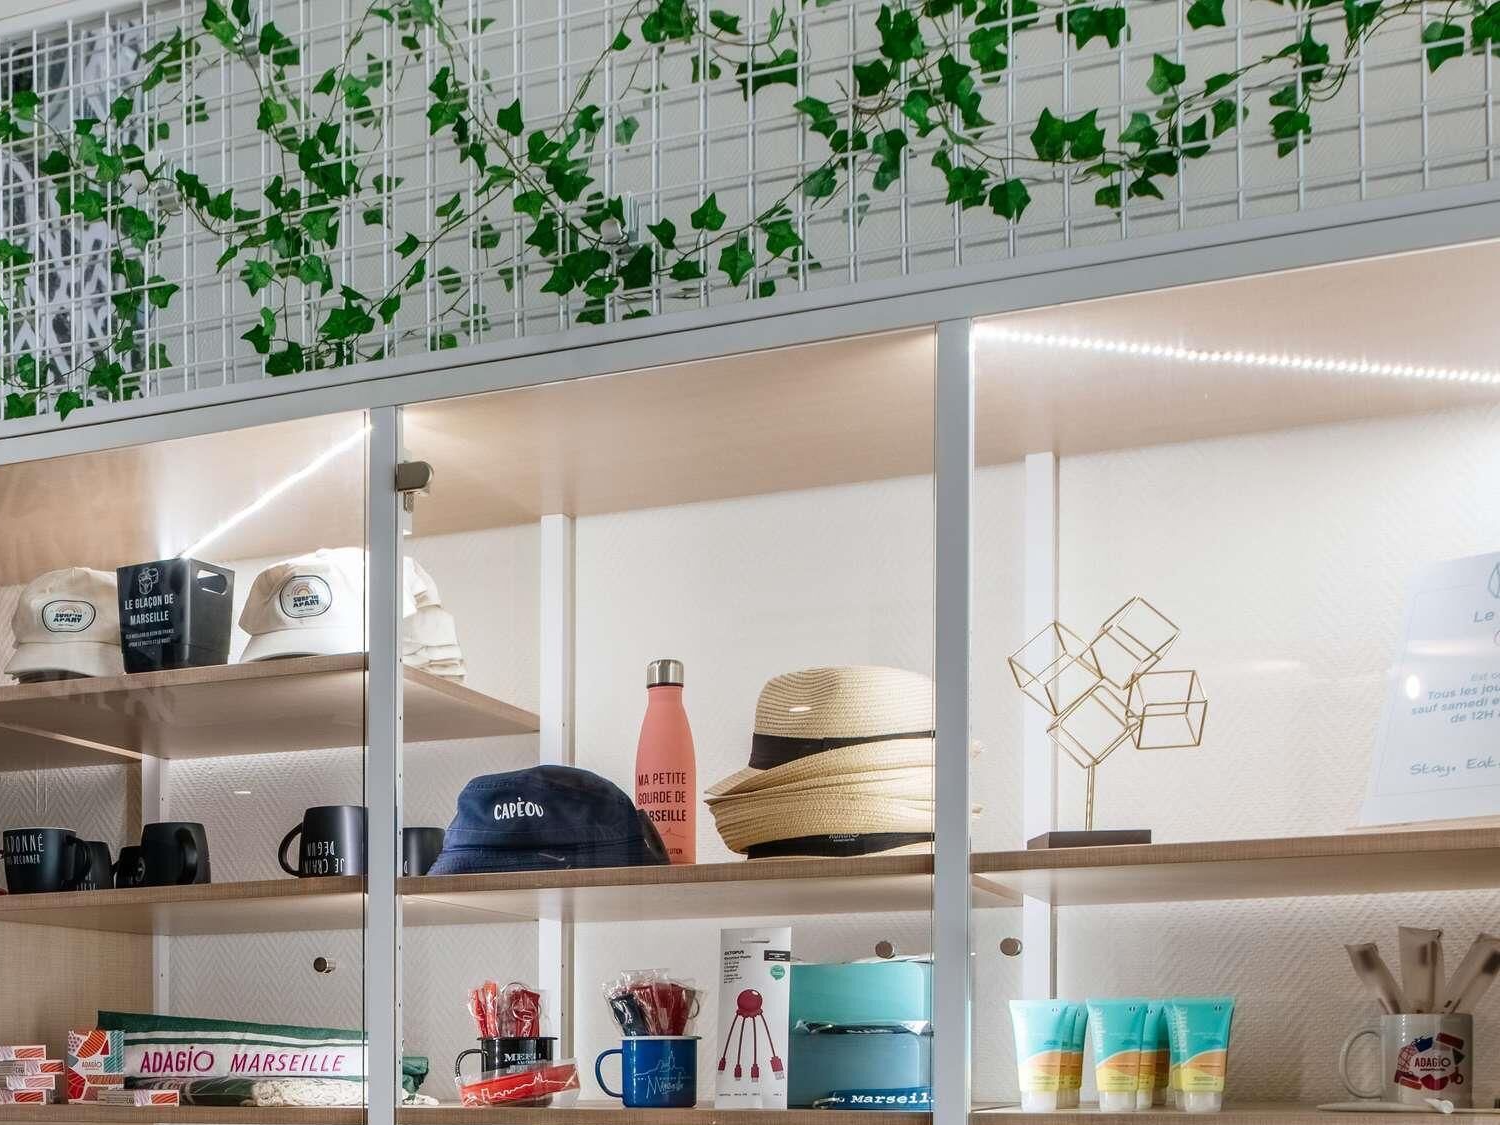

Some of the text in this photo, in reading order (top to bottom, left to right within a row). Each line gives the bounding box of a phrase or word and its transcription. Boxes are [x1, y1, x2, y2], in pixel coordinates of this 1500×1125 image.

[124, 599, 134, 610] LE
[164, 593, 174, 604] DE
[130, 609, 170, 625] MARSEILLE
[1473, 611, 1494, 623] Le
[638, 772, 686, 786] MA PETITE
[674, 791, 686, 803] DE
[231, 1053, 345, 1073] MARSEILLE
